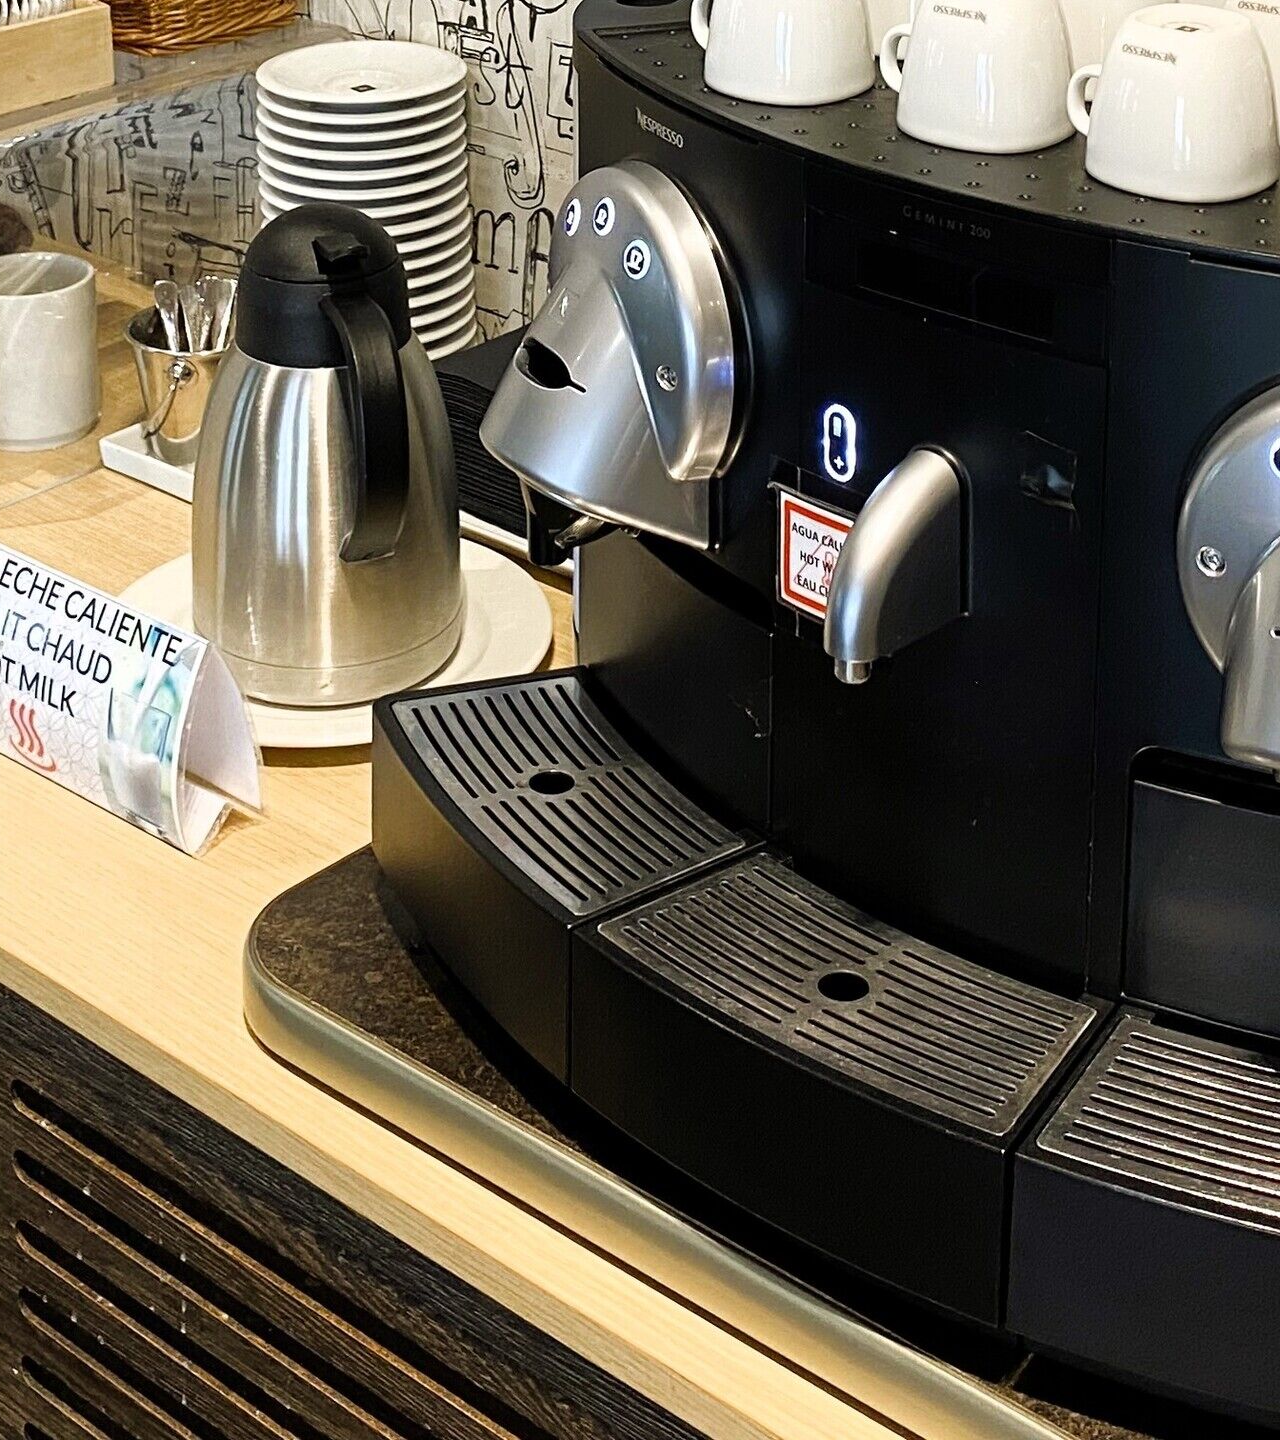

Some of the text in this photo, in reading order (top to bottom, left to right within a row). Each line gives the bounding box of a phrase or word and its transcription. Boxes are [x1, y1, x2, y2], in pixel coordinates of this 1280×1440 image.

[635, 106, 685, 149] NESPRESSO
[792, 522, 819, 543] AGUA
[800, 550, 820, 568] HOT
[796, 574, 817, 592] EAU
[64, 590, 183, 667] CALIENTE
[27, 621, 113, 685] CHAUD
[19, 663, 77, 718] MILK
